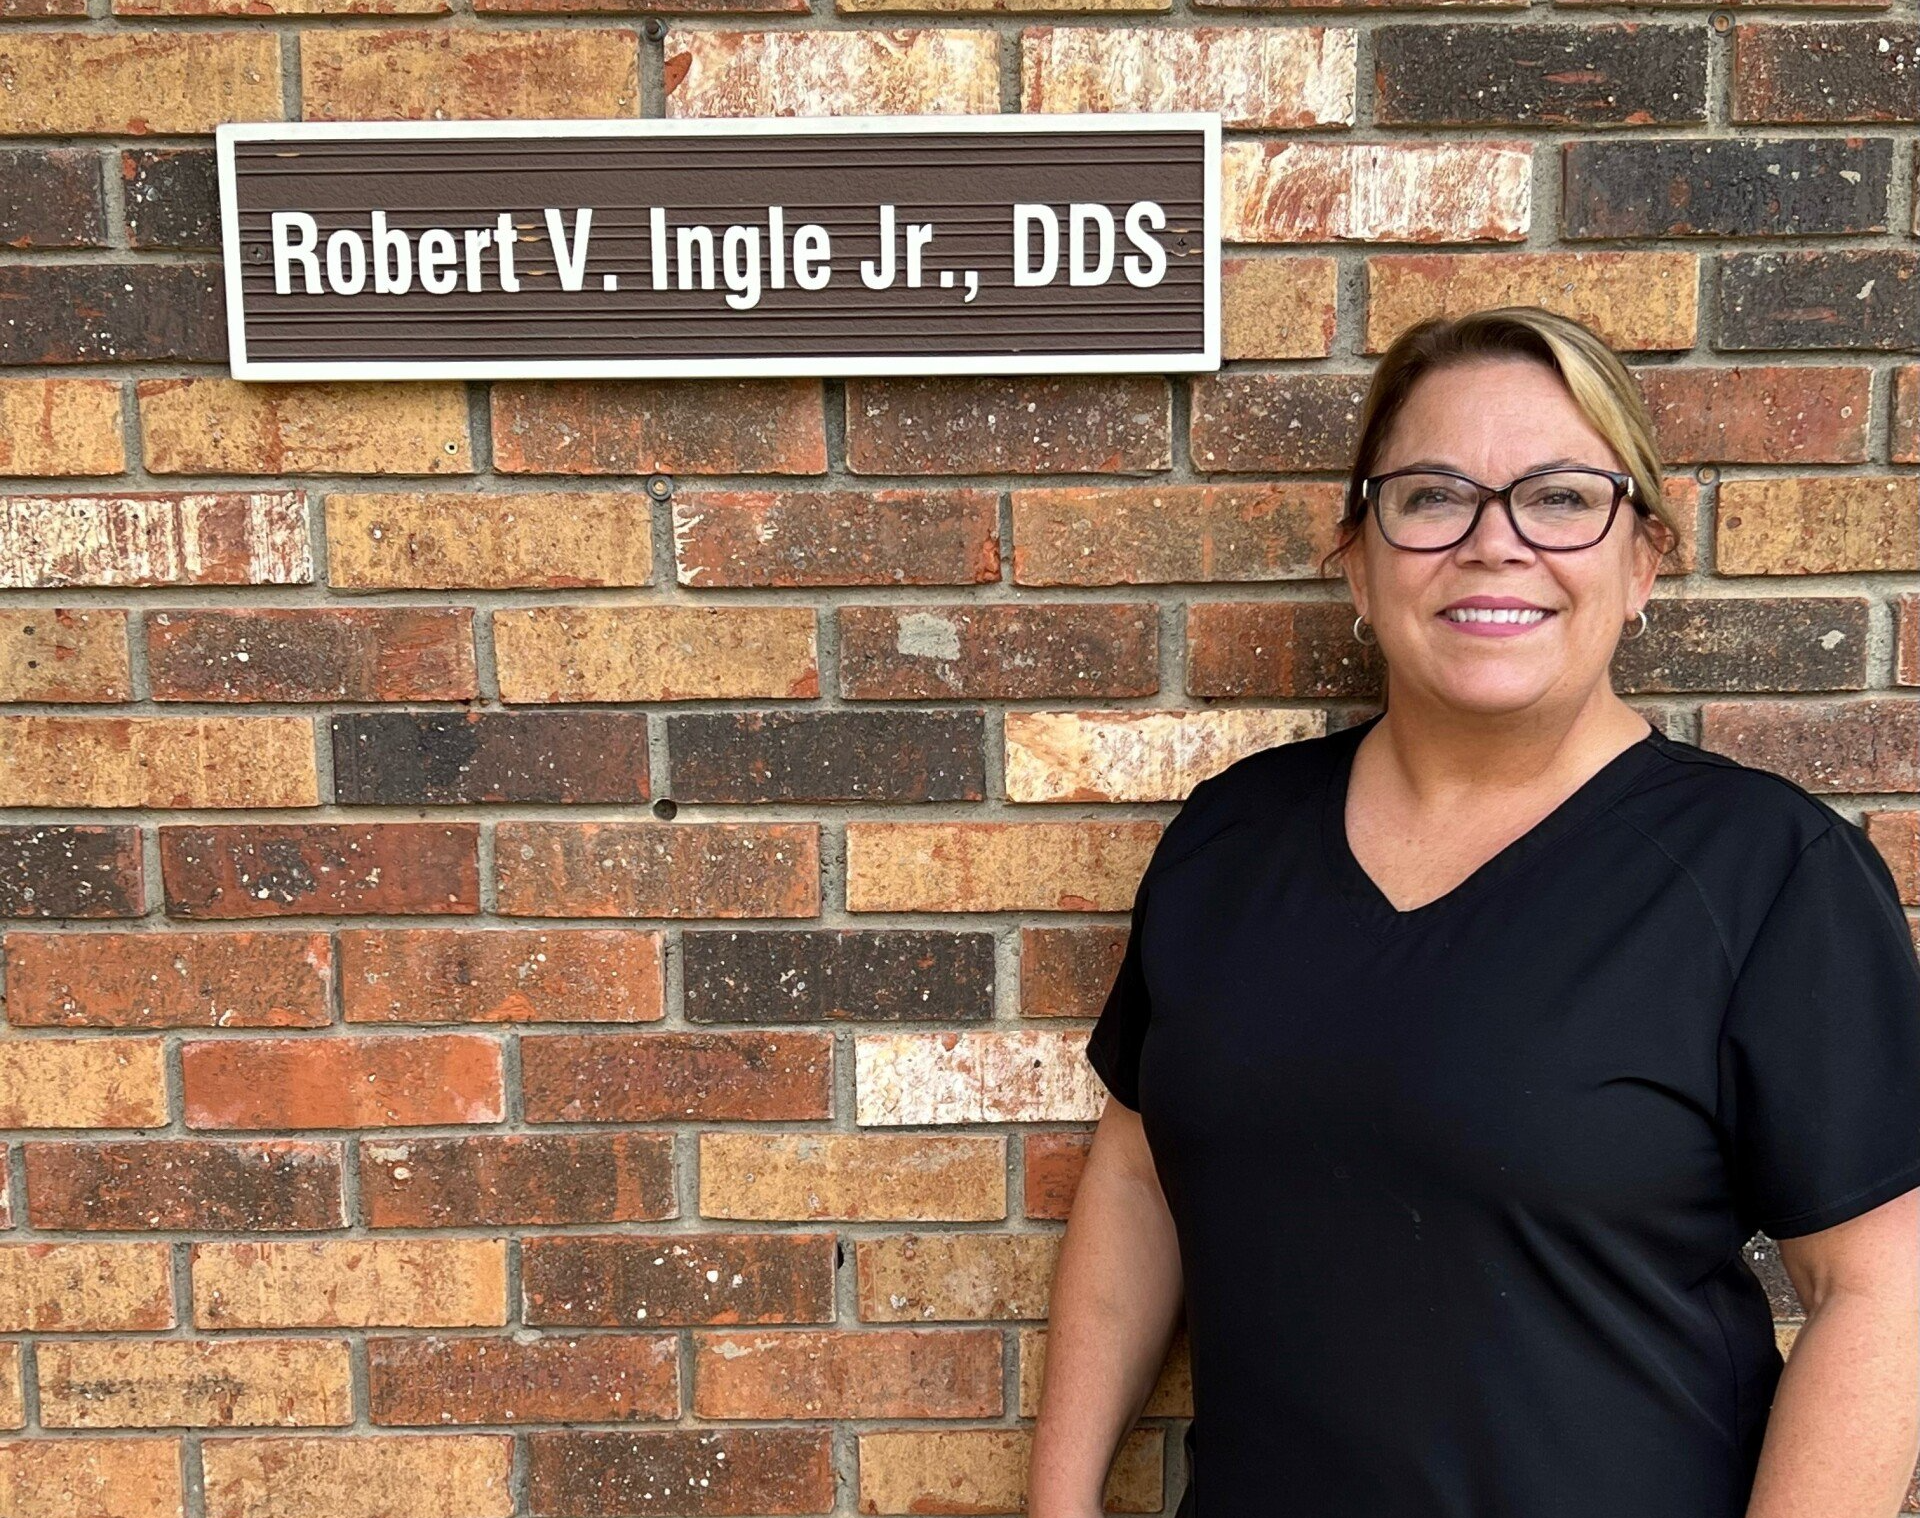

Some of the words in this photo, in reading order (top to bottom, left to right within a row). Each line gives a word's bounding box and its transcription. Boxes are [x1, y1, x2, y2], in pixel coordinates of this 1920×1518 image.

[271, 209, 520, 295] Robert
[544, 208, 618, 292] V.
[650, 204, 831, 310] Ingle
[860, 203, 979, 303] Jr.,
[1013, 200, 1167, 288] DDS
